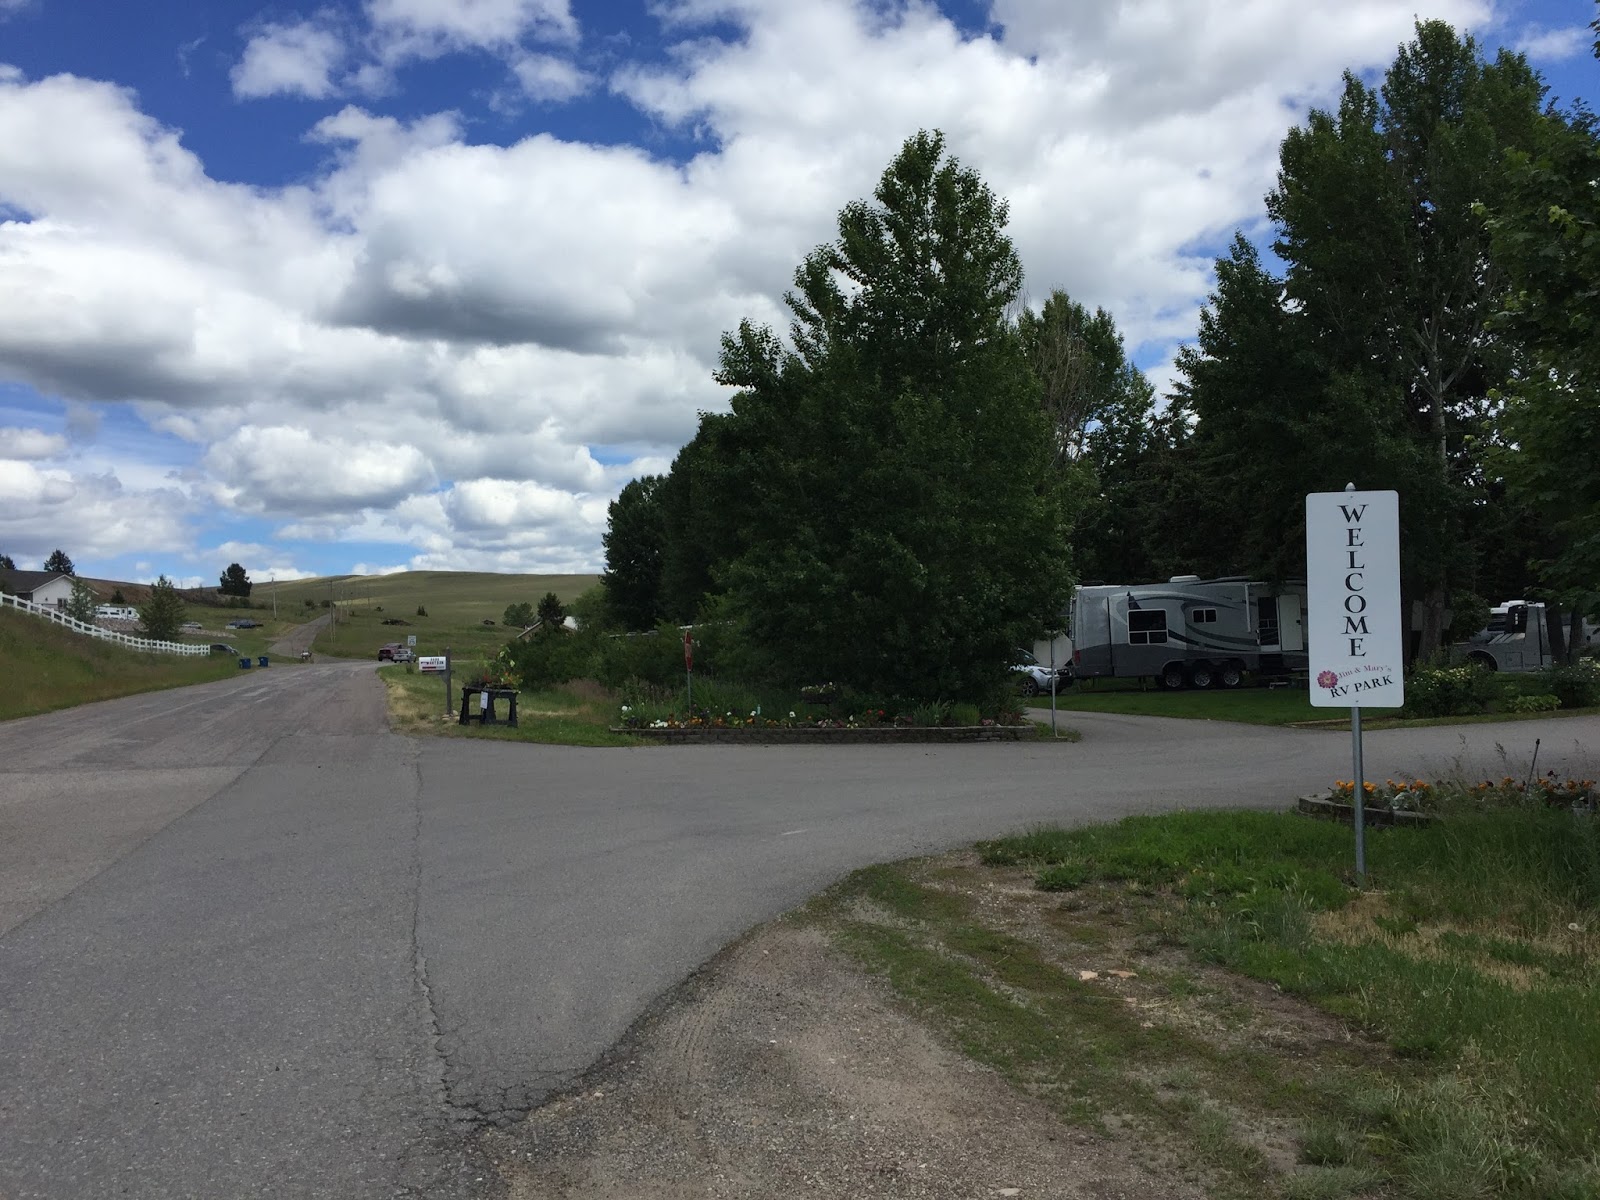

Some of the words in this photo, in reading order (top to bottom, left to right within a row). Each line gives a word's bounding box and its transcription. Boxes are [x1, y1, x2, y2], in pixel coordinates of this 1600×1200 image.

[1337, 504, 1371, 657] WELCOME
[1363, 664, 1392, 673] Mary's
[1330, 685, 1349, 698] RV
[1354, 675, 1394, 692] PARK
